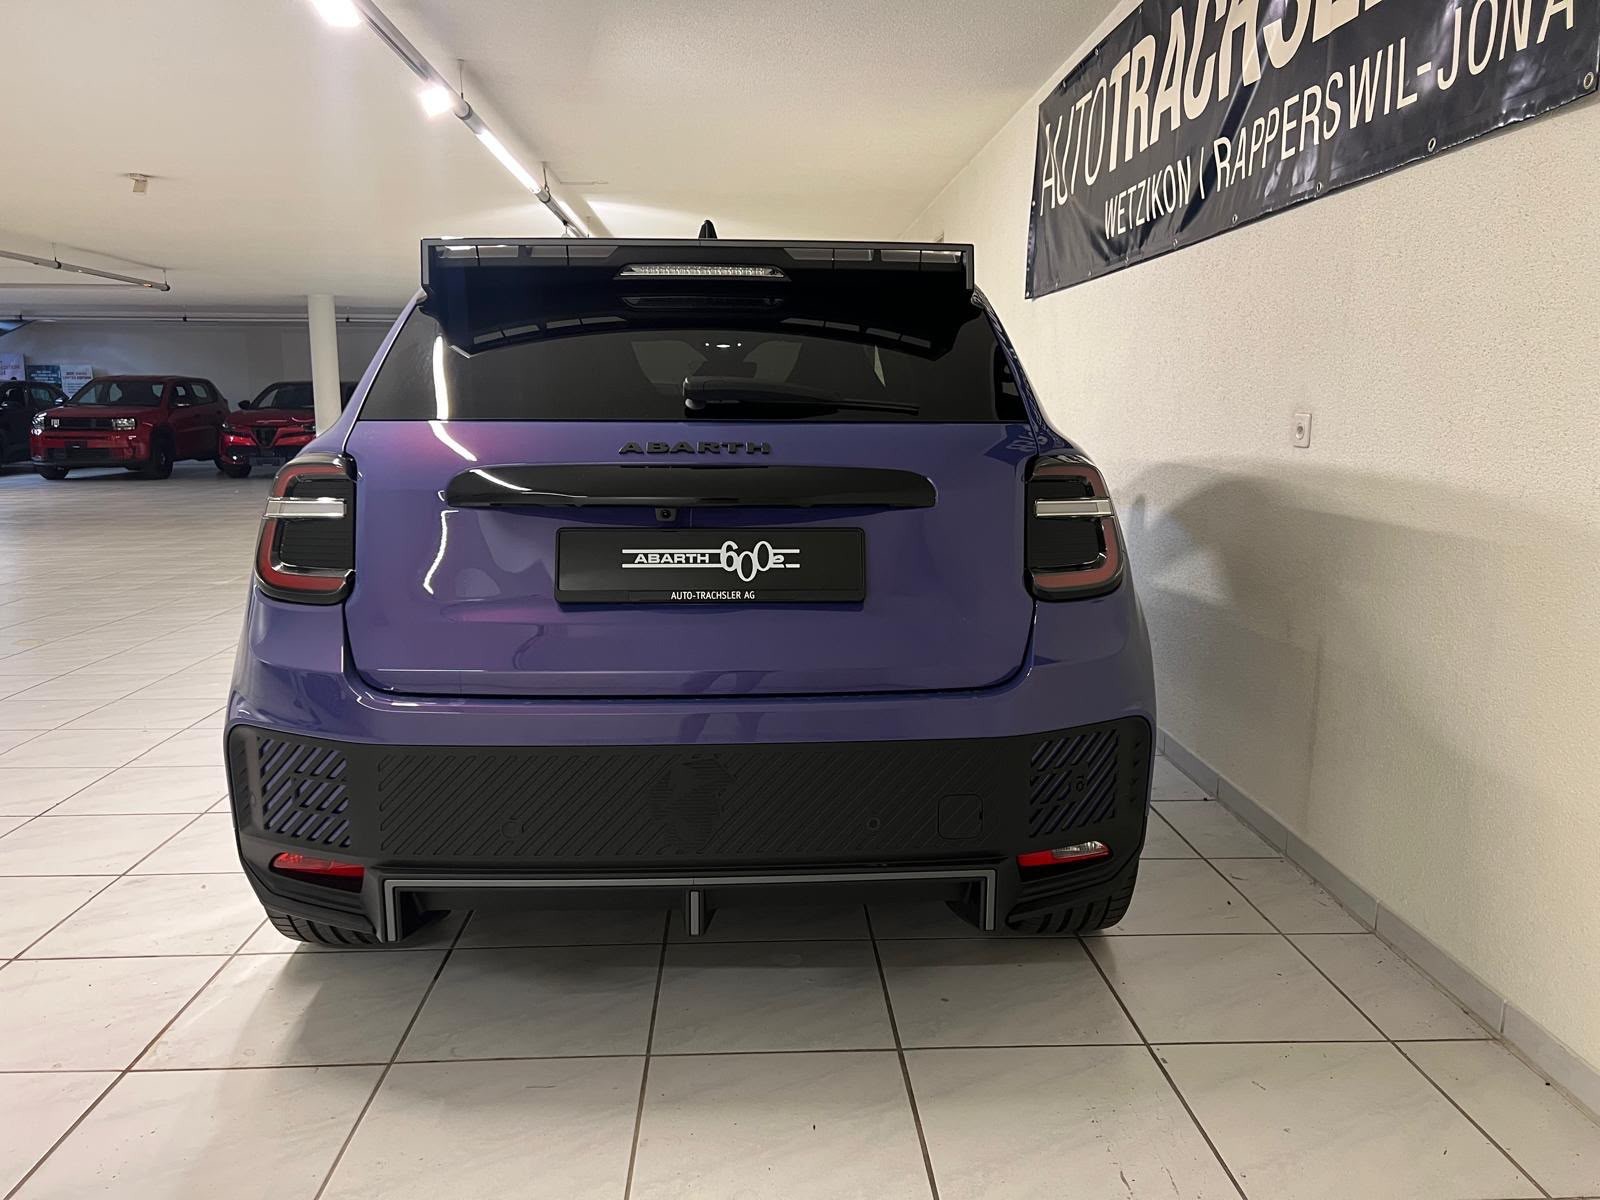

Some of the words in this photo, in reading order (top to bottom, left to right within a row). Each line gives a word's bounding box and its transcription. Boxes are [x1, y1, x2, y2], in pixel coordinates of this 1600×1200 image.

[1039, 0, 1383, 217] AUTOTRACH
[1105, 155, 1191, 240] WETZIKON
[619, 441, 771, 454] ABARTH
[634, 553, 710, 564] ABARTH
[671, 591, 741, 600] AUTO-TRACHSLER
[744, 590, 755, 599] AG
